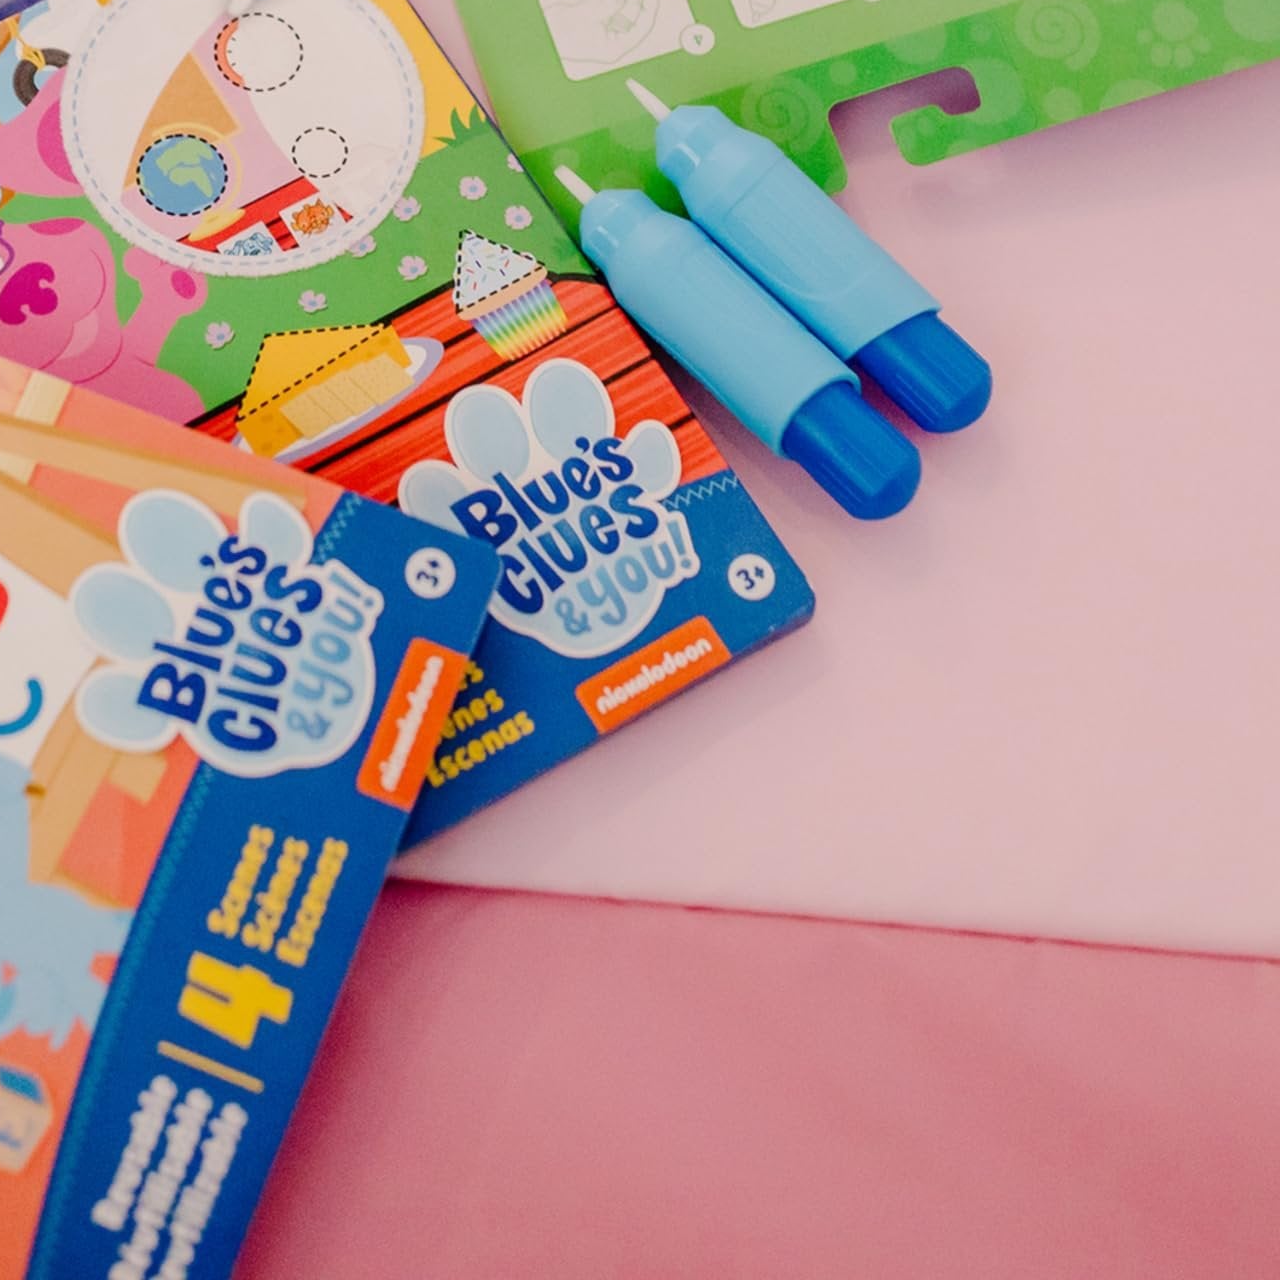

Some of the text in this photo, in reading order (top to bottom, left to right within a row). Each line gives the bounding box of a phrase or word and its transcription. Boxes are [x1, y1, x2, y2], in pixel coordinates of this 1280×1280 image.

[450, 437, 634, 548] Blue's
[416, 558, 443, 587] 3+
[736, 565, 765, 591] 3+
[137, 534, 268, 725] Blue's
[595, 637, 712, 715] nickelodeon
[177, 950, 293, 1050] 4
